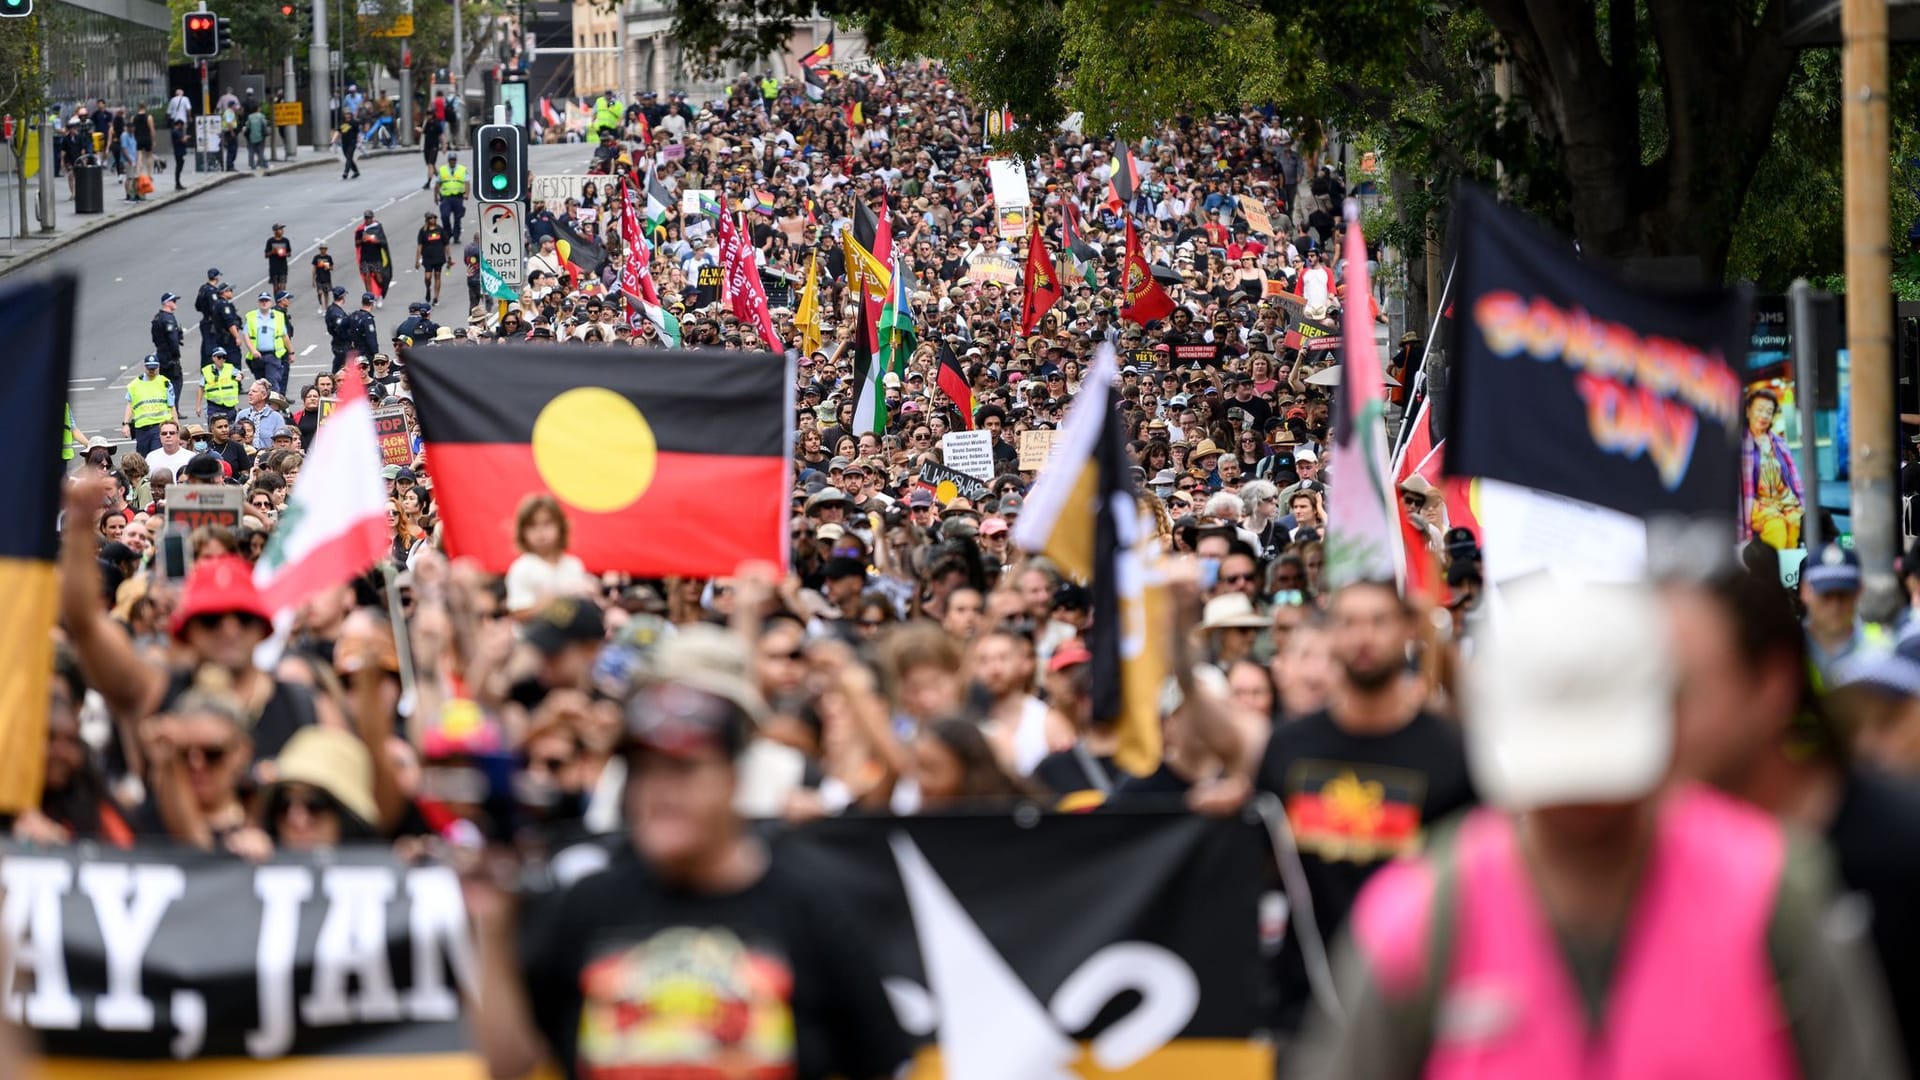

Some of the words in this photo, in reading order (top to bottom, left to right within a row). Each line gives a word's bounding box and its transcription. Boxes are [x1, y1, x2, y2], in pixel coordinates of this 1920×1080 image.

[537, 177, 574, 198] RESIST
[490, 242, 511, 255] NO
[487, 258, 517, 268] RIGHT
[700, 268, 725, 278] ALWA
[1298, 322, 1330, 339] TREA
[375, 418, 402, 433] TOP
[383, 447, 408, 457] ATHS
[174, 511, 234, 529] STOP
